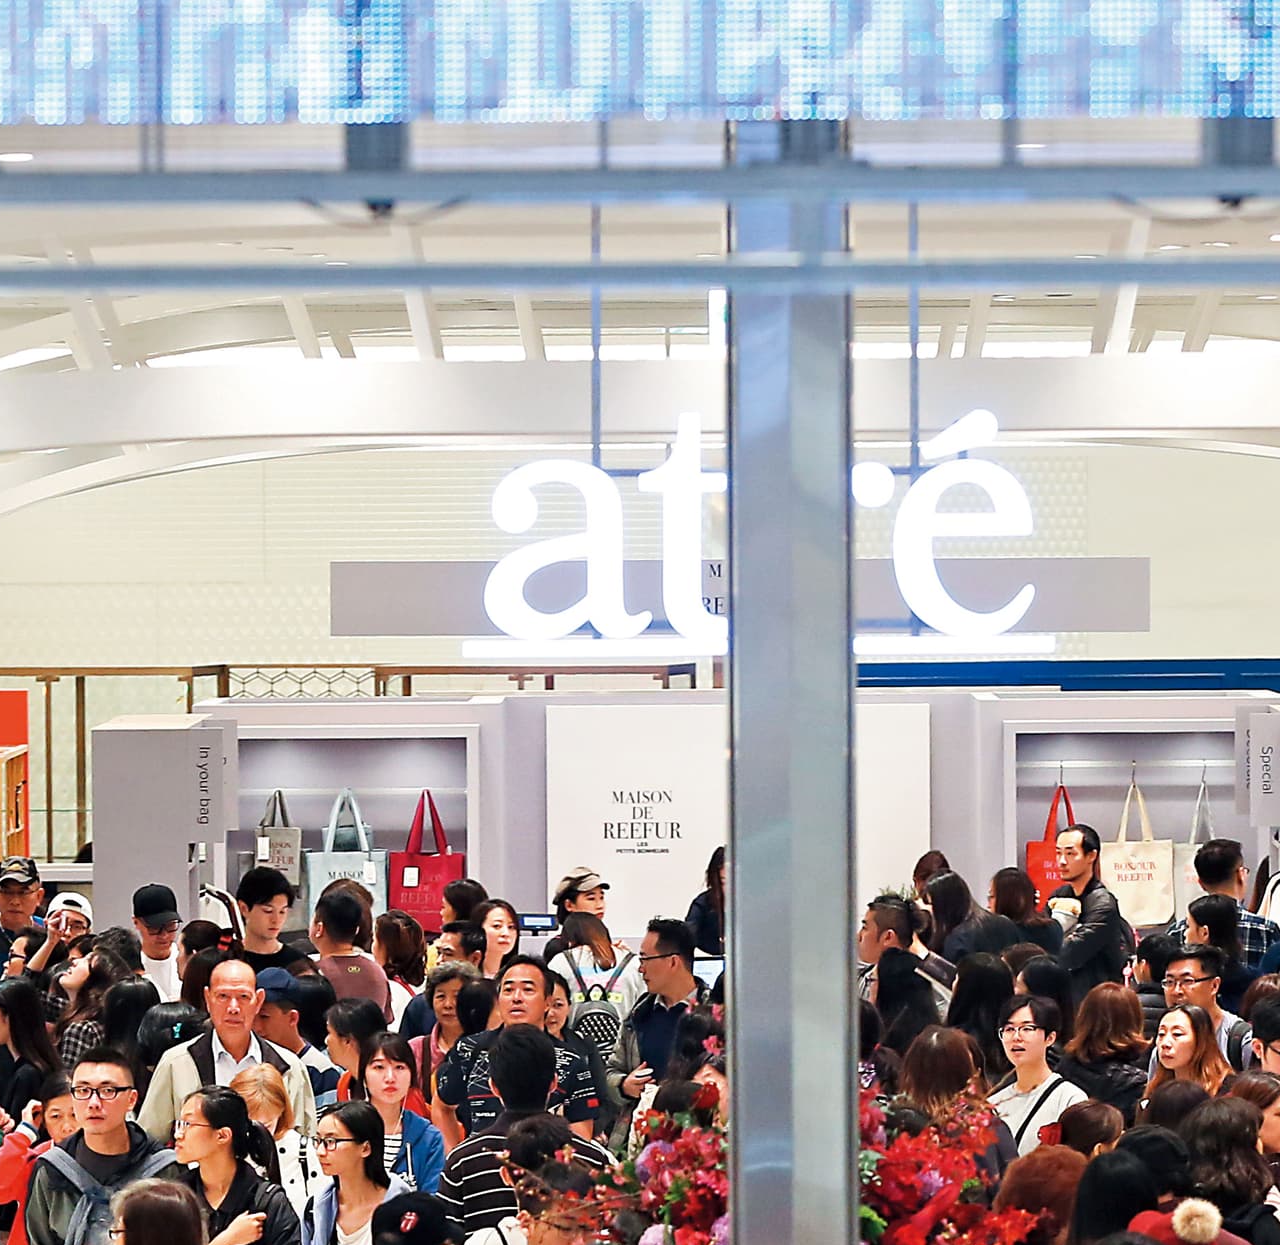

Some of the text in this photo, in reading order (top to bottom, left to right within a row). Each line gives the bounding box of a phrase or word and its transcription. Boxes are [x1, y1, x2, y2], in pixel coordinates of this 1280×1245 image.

[483, 408, 1036, 640] até
[1259, 746, 1274, 794] Special
[196, 746, 211, 825] In your bag
[612, 790, 672, 804] MAISON
[632, 806, 653, 820] DE
[603, 822, 682, 839] REEFUR
[1117, 872, 1154, 881] REEFUR
